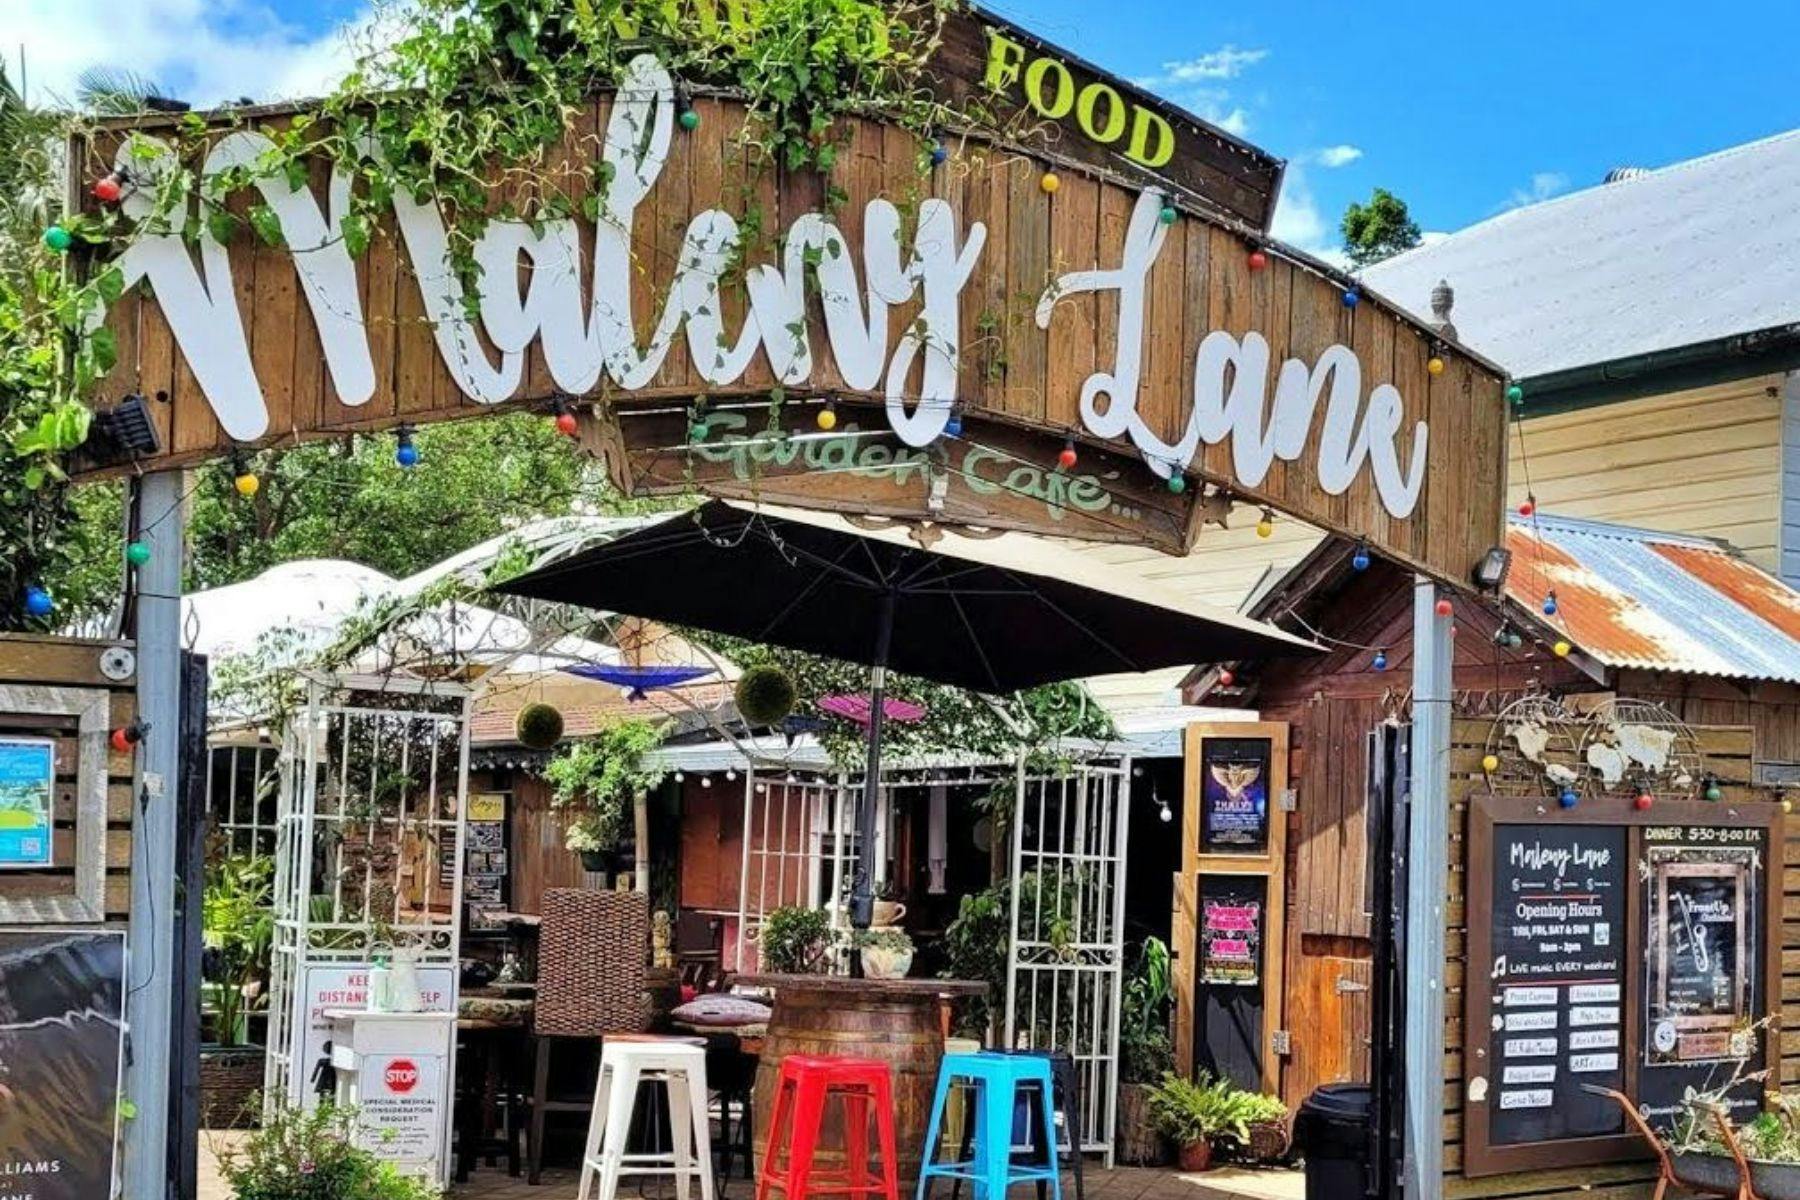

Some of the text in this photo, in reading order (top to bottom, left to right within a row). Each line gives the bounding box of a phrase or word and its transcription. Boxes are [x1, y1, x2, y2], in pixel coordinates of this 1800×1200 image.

[984, 27, 1175, 167] FOOD
[98, 53, 1428, 518] Maleny Lane
[697, 410, 945, 485] Garden
[1645, 828, 1683, 841] DINNER
[1510, 841, 1611, 877] Maleny Lane
[1516, 902, 1602, 921] Opening Hours
[1510, 963, 1529, 974] LIVE
[347, 974, 369, 987] KEE
[420, 991, 441, 1004] ELP
[386, 1068, 417, 1084] STOP
[401, 1098, 436, 1106] MEDICAL
[366, 1106, 433, 1114] CONSIDERATION
[380, 1115, 418, 1123] REQUEST
[0, 1160, 60, 1174] LIAMS
